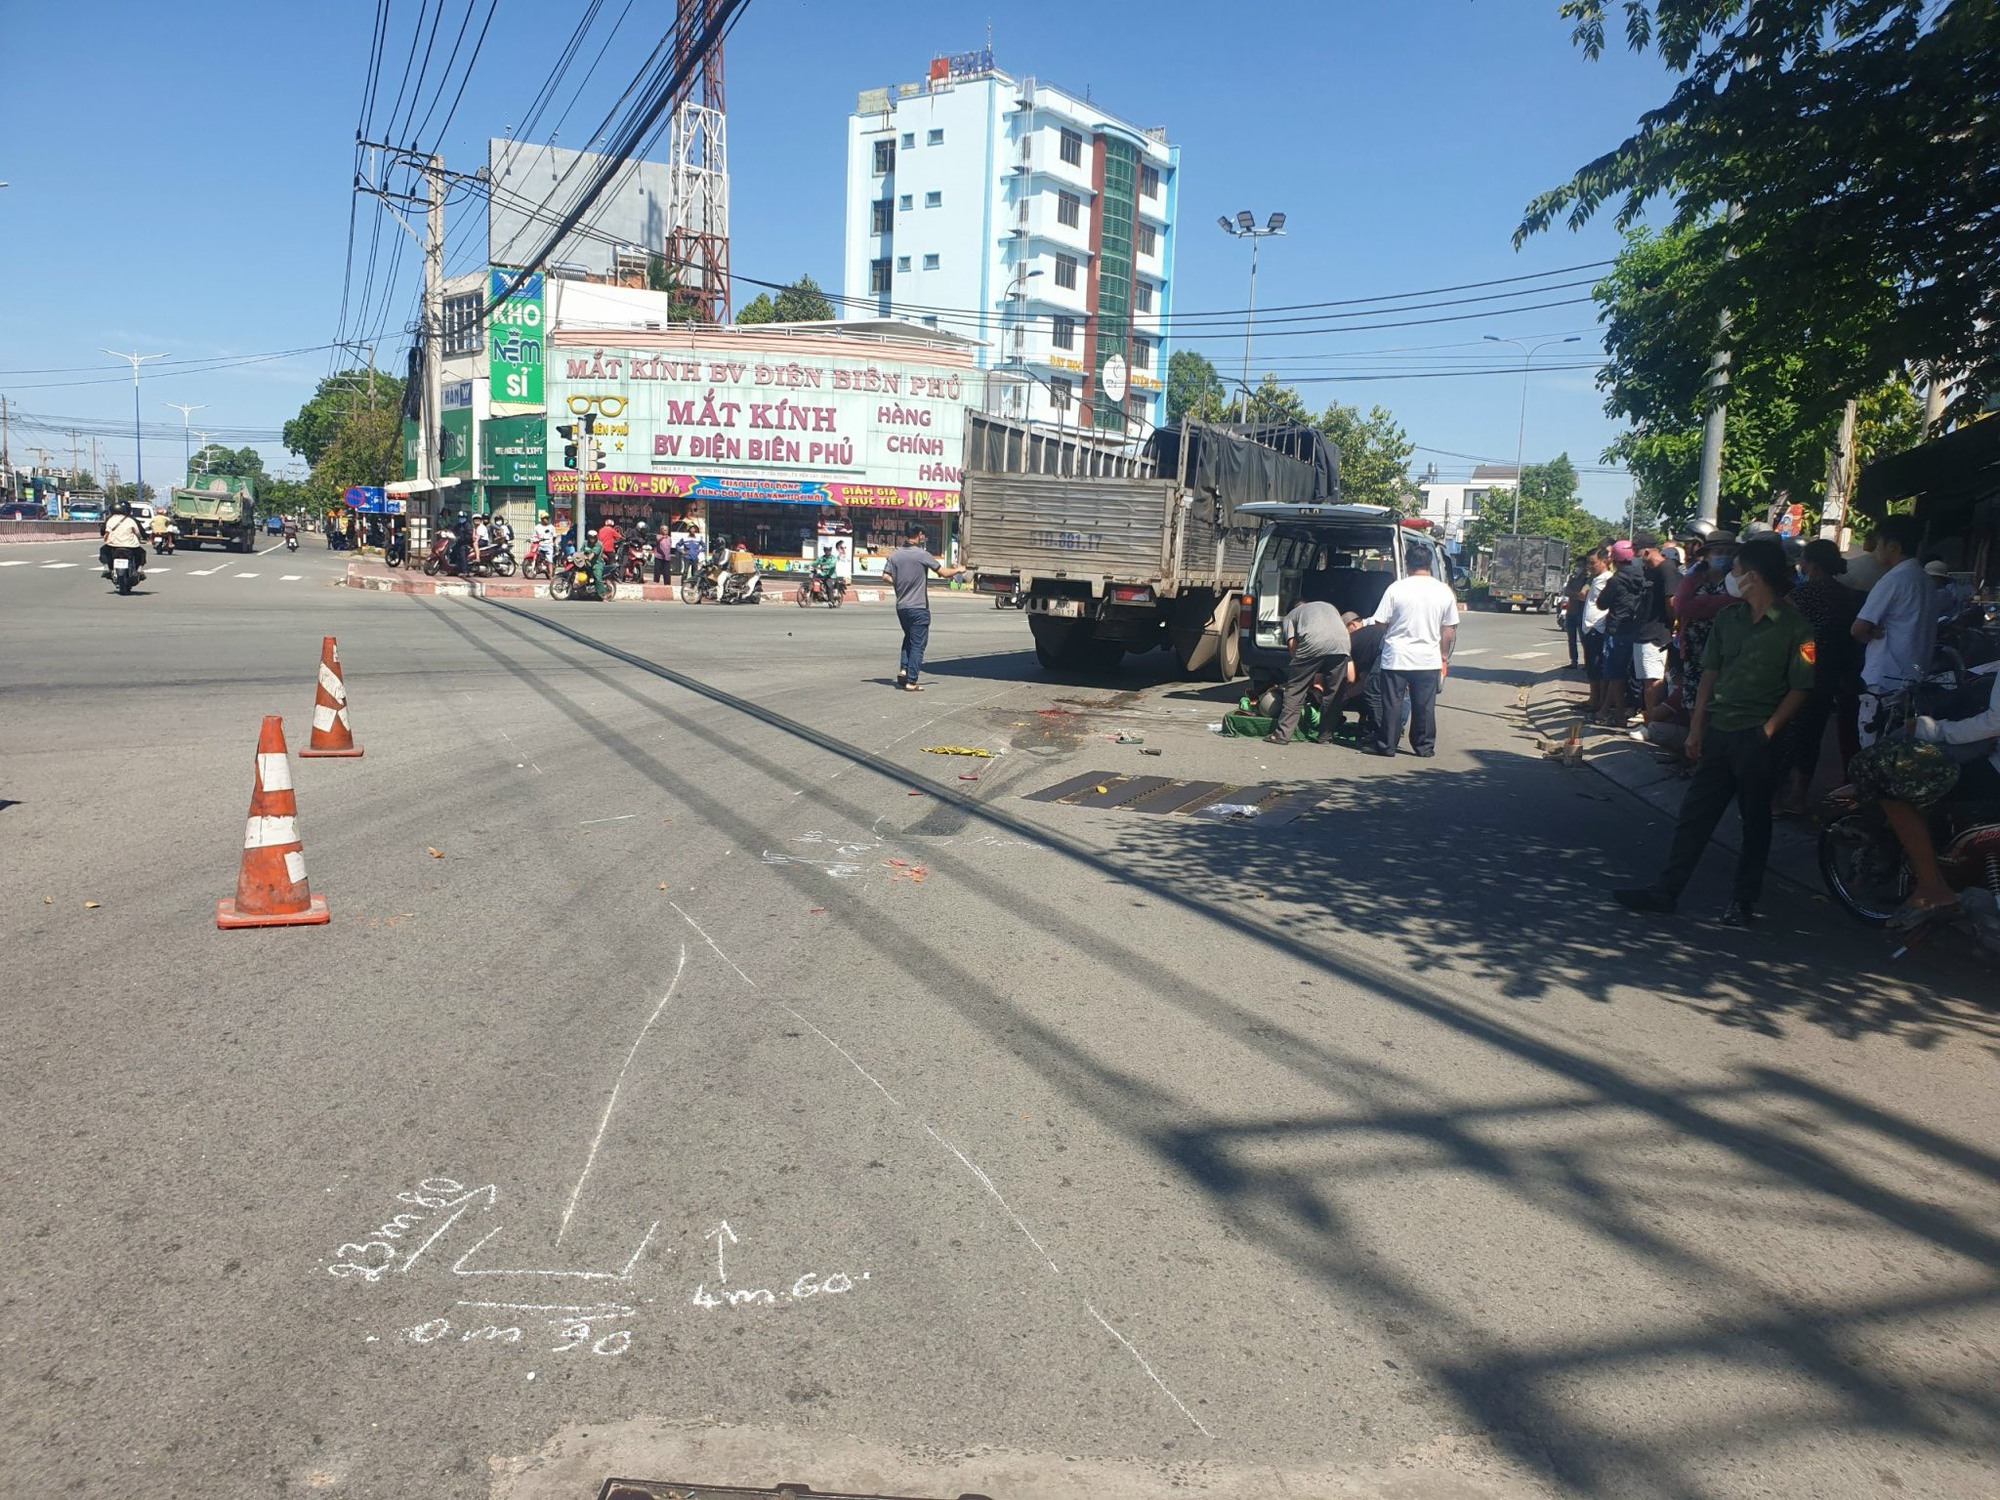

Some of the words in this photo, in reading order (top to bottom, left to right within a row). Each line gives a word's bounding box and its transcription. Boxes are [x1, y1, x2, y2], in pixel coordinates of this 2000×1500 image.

[493, 302, 541, 327] KHO
[630, 355, 701, 381] KÍNH
[709, 362, 746, 383] BV
[755, 361, 823, 391] ĐIỆN
[833, 367, 900, 394] BIÊN
[910, 374, 962, 400] PHỦ
[749, 398, 837, 432] KÍNH
[877, 402, 931, 427] HÀNG
[654, 434, 682, 456] BV
[690, 432, 740, 462] ĐIỆN
[748, 435, 800, 462] BIÊN
[809, 436, 853, 465] PHỦ
[887, 433, 943, 456] CHÍNH
